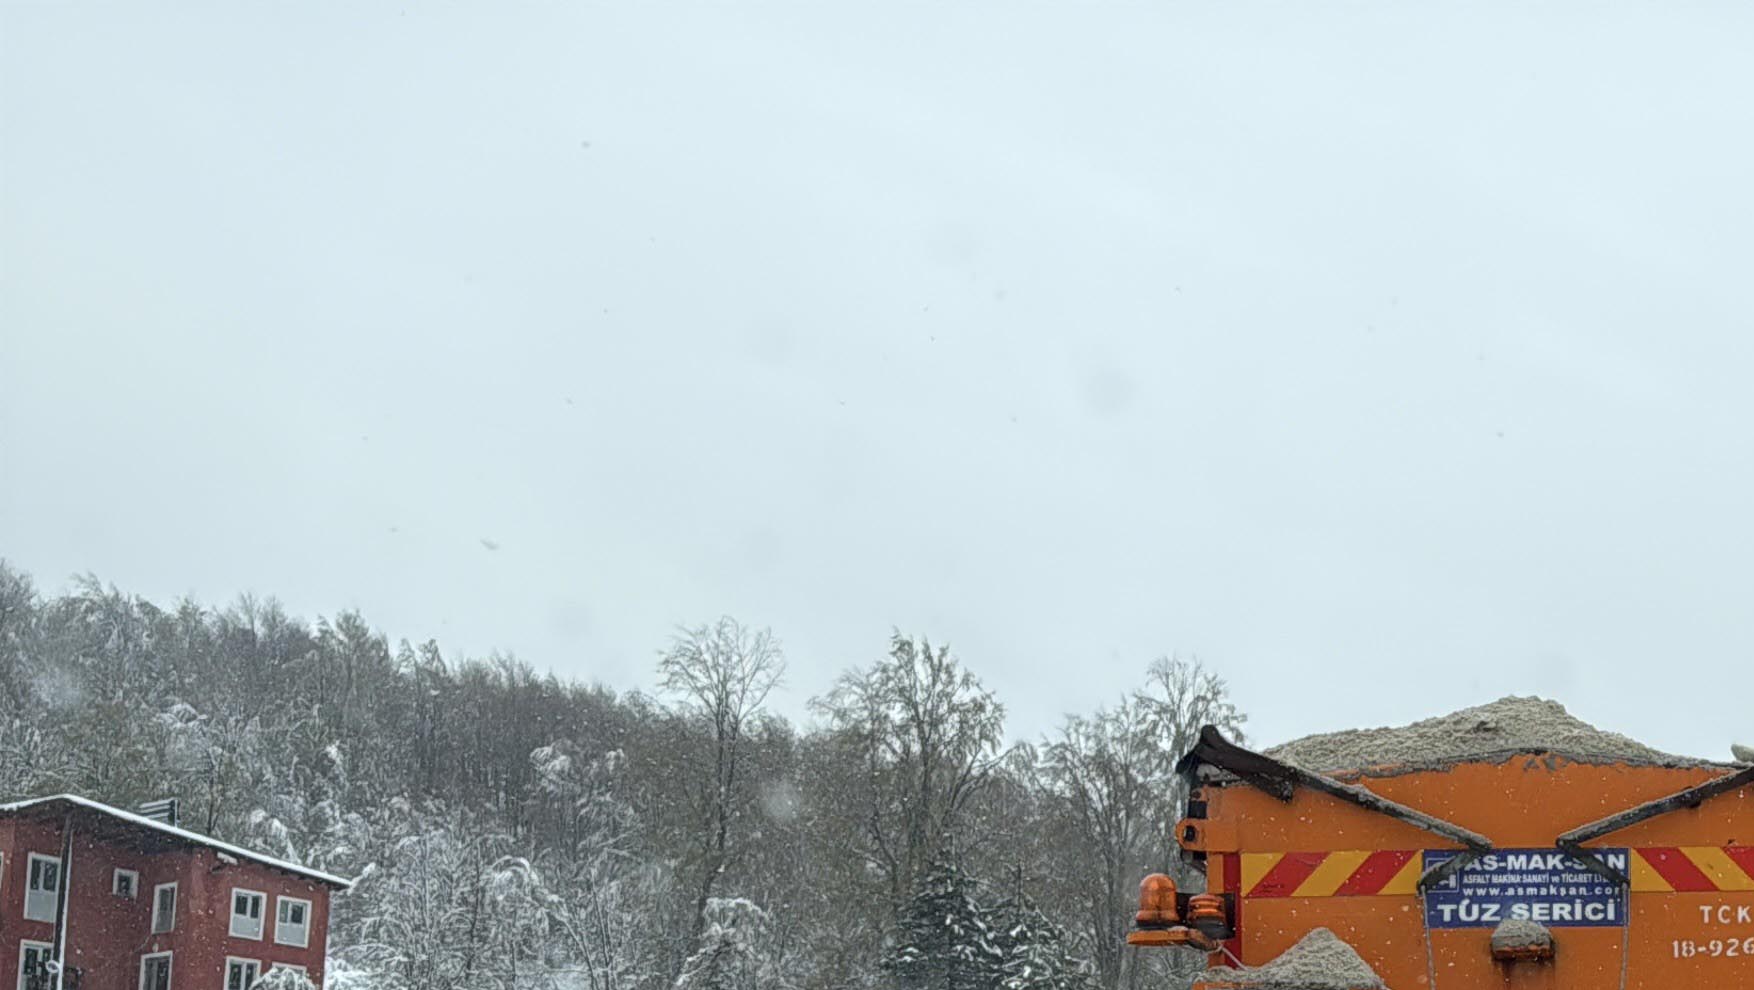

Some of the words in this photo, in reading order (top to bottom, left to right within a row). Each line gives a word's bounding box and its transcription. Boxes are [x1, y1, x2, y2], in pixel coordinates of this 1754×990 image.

[1463, 873, 1490, 884] ASFALT
[1551, 875, 1560, 884] ve
[1561, 871, 1593, 884] TİCARET
[1511, 898, 1616, 922] SERİCİ
[1699, 905, 1752, 924] TCK
